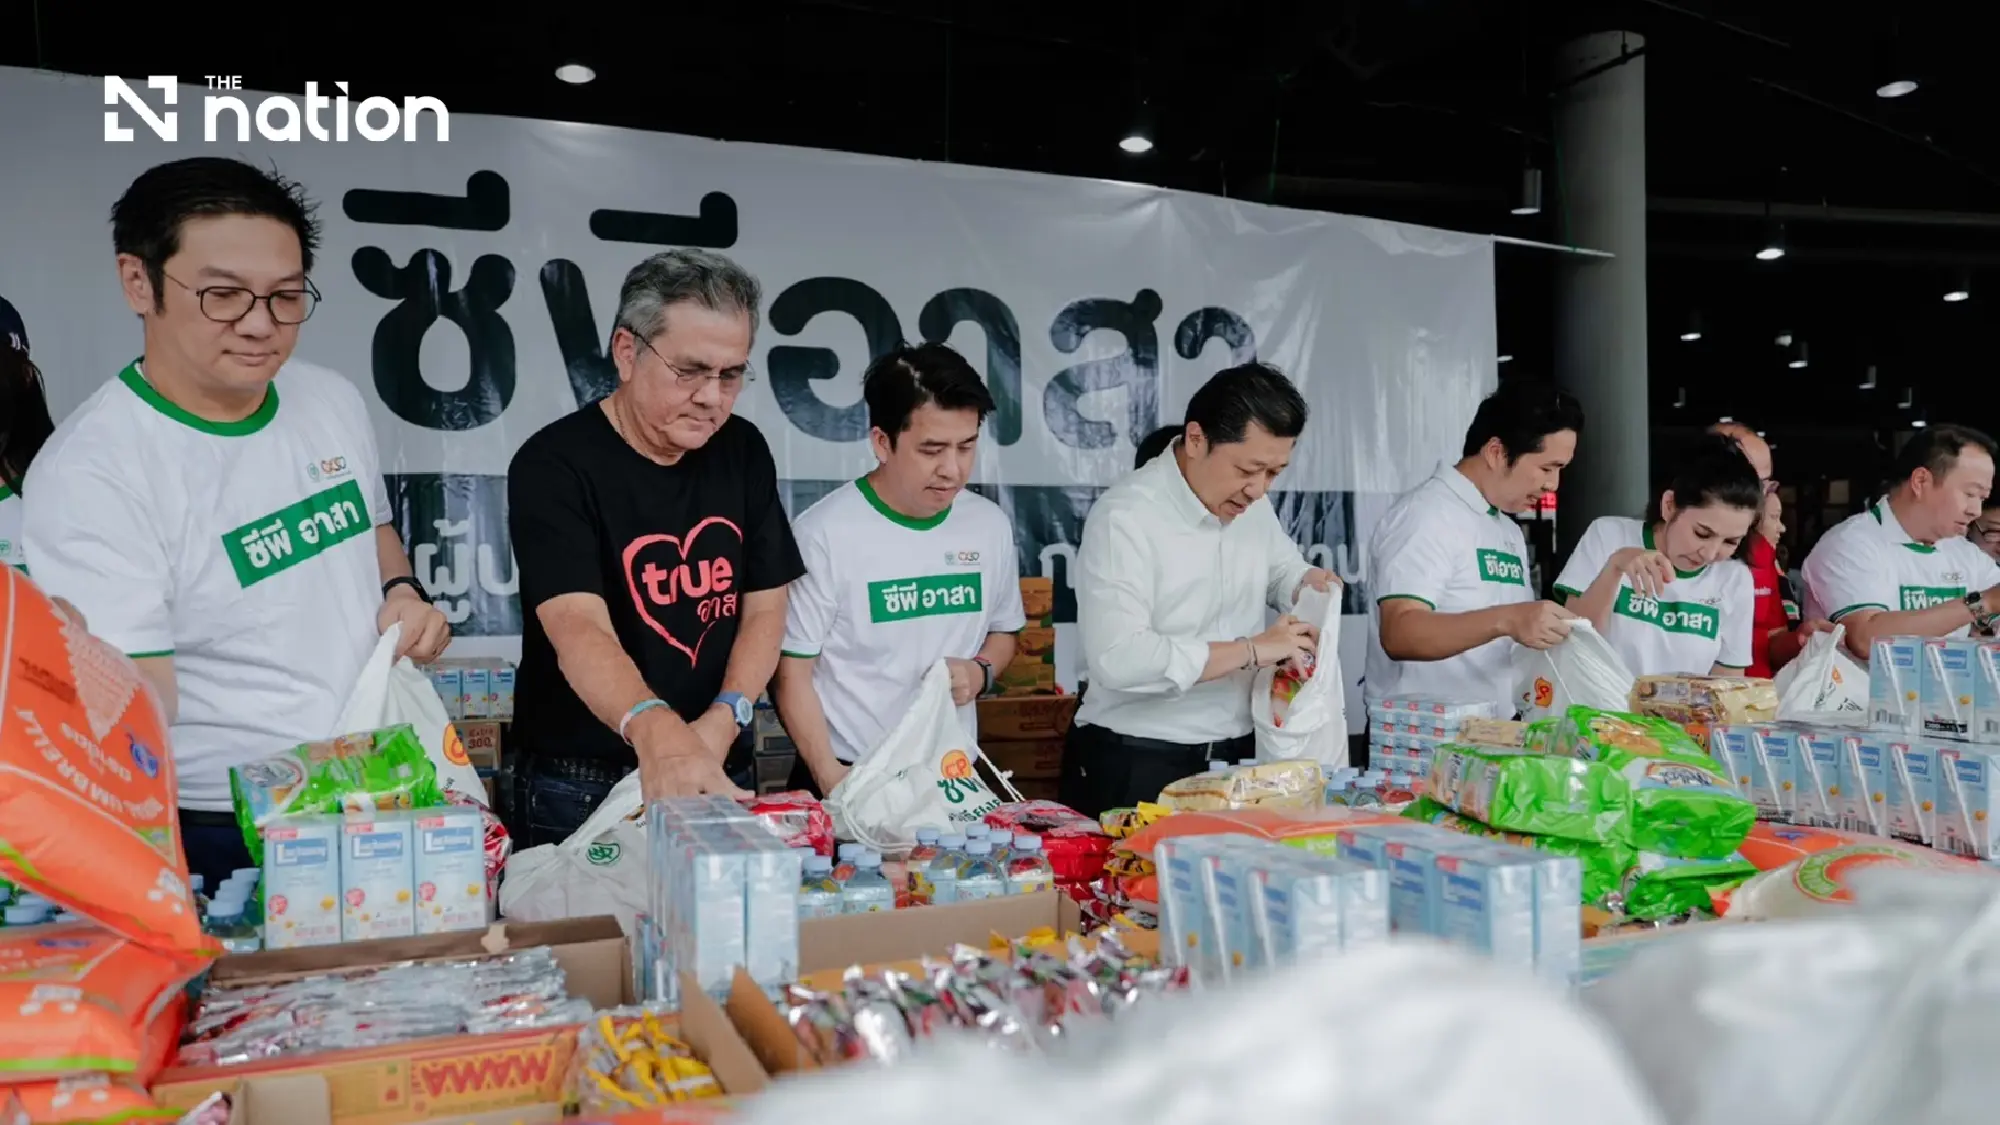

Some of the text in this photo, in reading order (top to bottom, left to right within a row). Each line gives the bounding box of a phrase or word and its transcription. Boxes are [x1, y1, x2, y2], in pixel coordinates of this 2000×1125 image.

[240, 500, 360, 569] ซีพี อาสา
[641, 556, 734, 606] true
[881, 582, 976, 613] ซีพี อาสา
[696, 592, 738, 623] อาส
[1662, 610, 1713, 633] อาสา
[420, 1050, 552, 1098] MAMA
